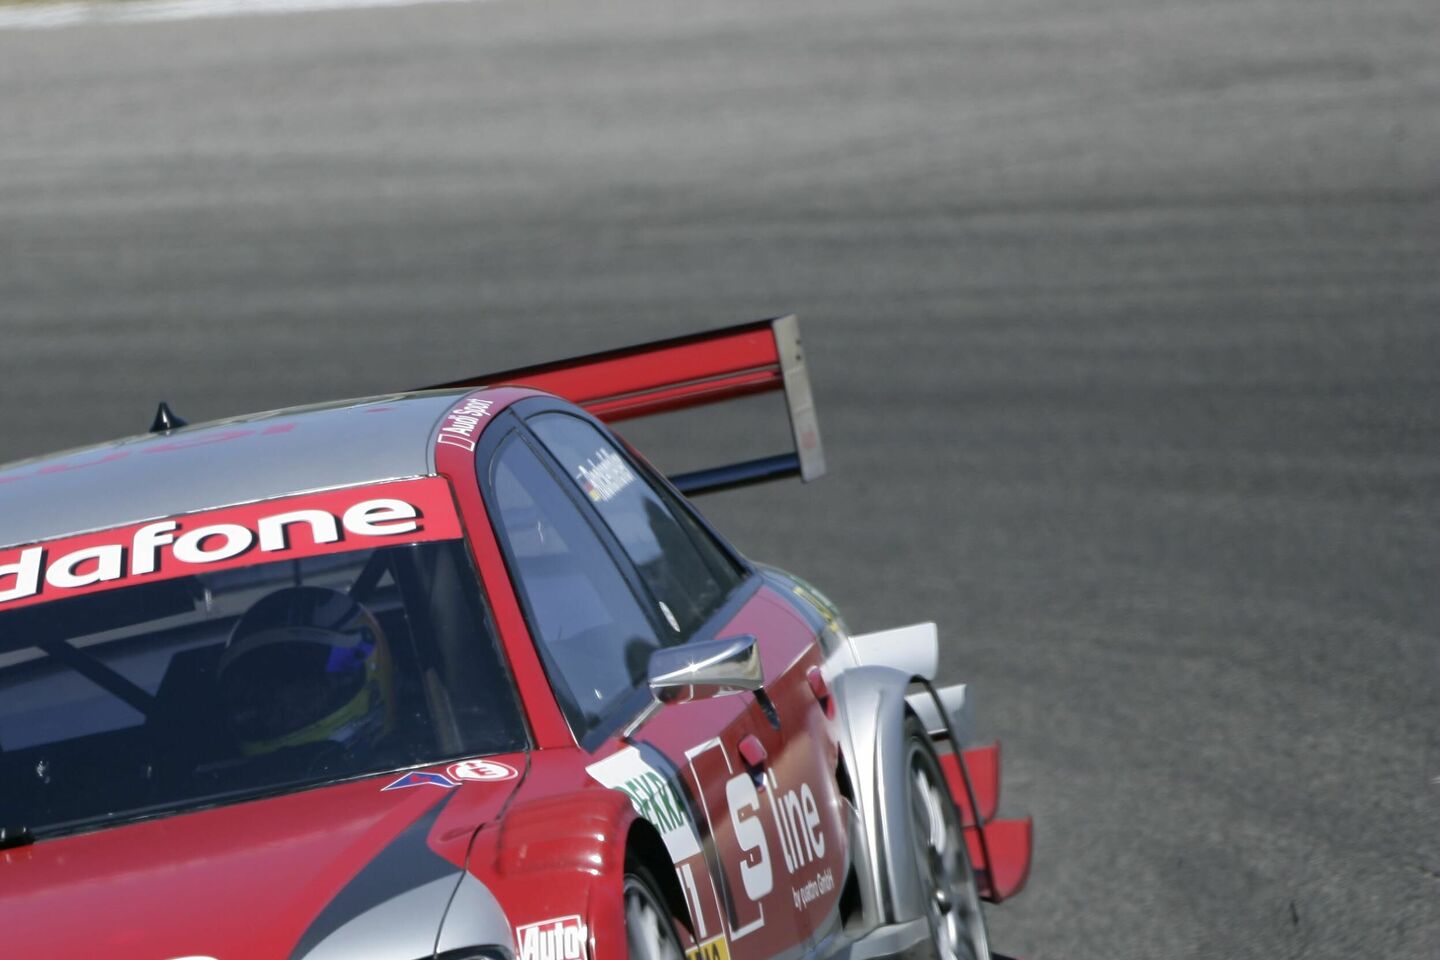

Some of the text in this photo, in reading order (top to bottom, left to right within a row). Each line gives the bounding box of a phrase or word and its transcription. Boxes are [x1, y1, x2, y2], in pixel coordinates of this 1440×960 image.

[442, 398, 494, 437] Audi Sport
[725, 767, 826, 901] S line
